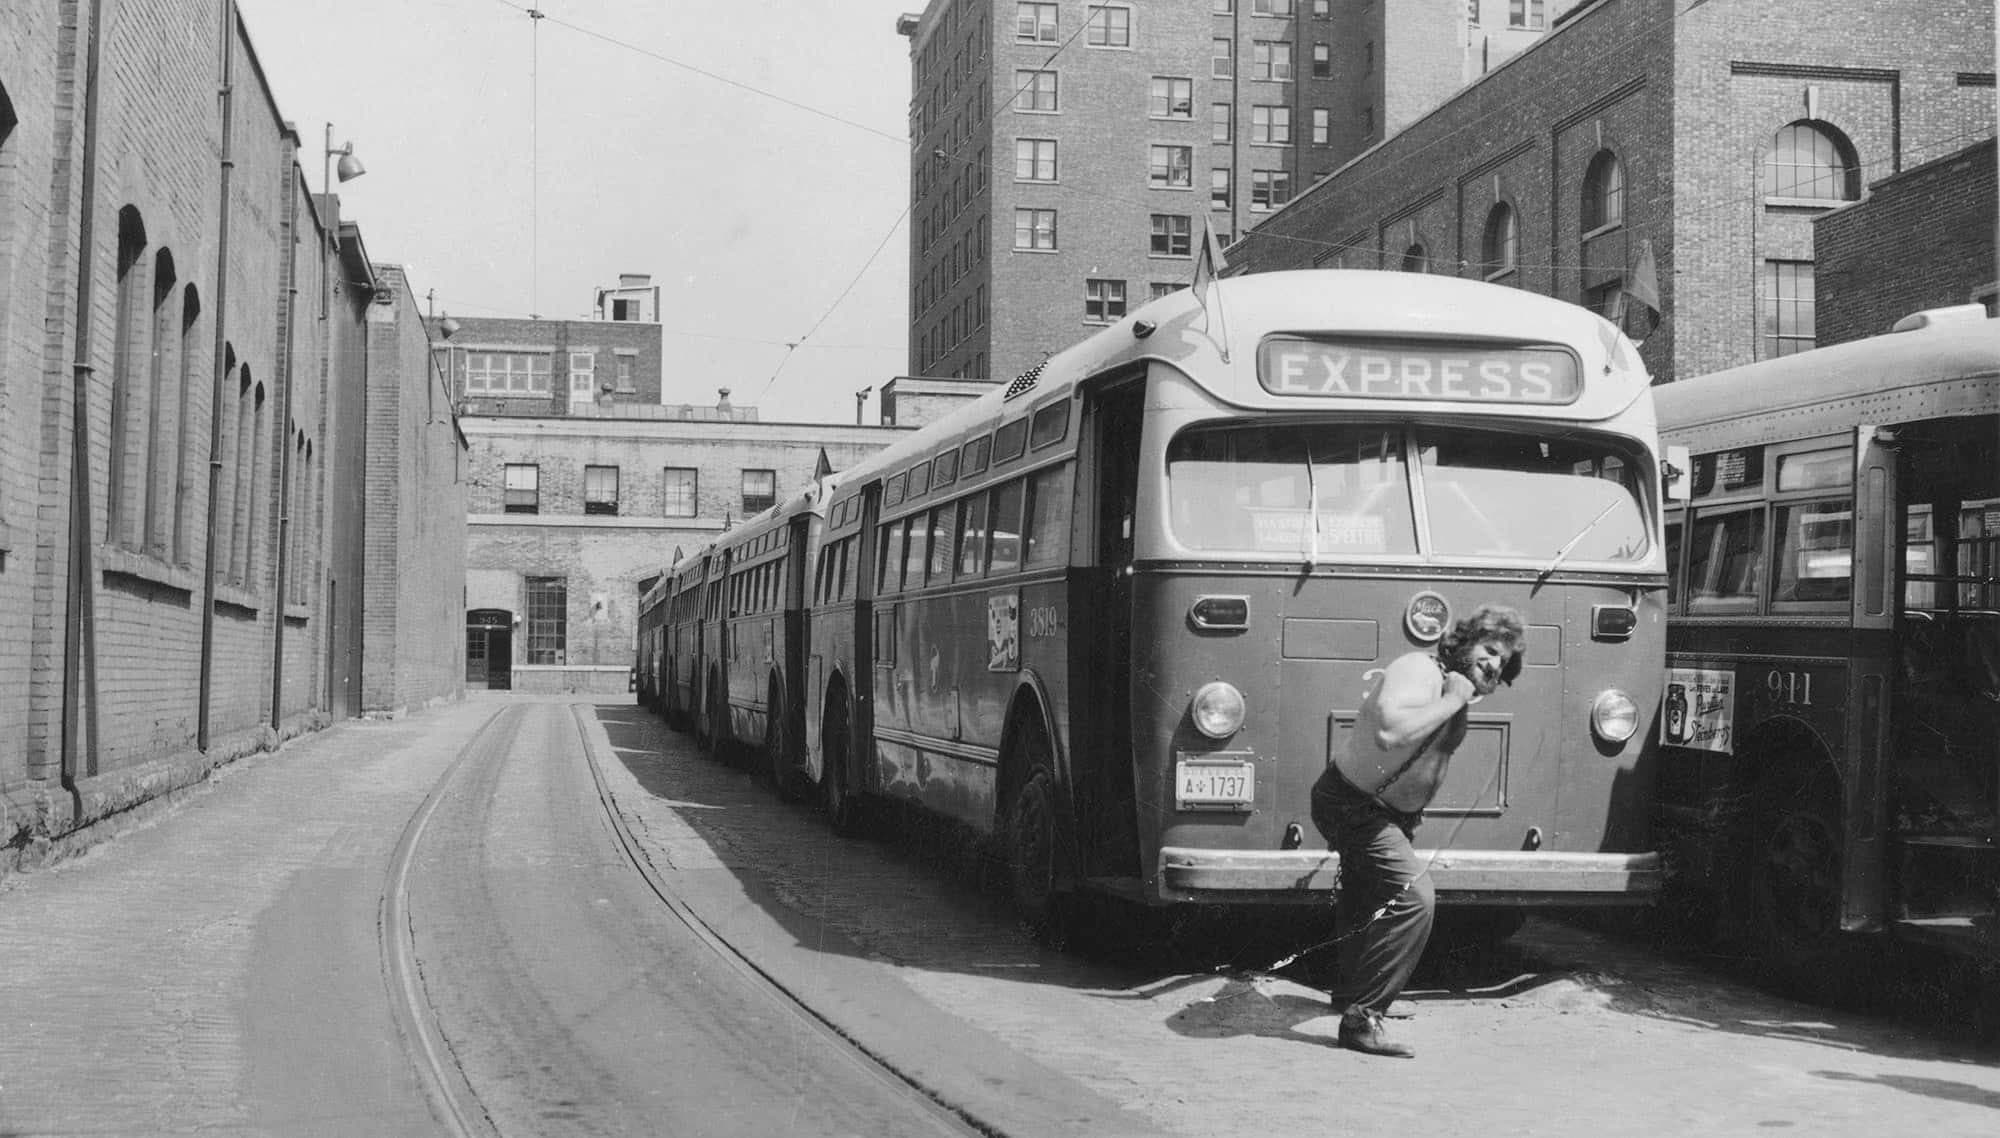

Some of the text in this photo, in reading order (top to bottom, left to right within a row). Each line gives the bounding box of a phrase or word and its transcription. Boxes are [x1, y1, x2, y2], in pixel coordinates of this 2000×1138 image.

[1280, 353, 1552, 398] EXPRESS
[1030, 606, 1056, 637] 3819
[1768, 670, 1812, 705] 911
[1185, 776, 1246, 798] A 1737
